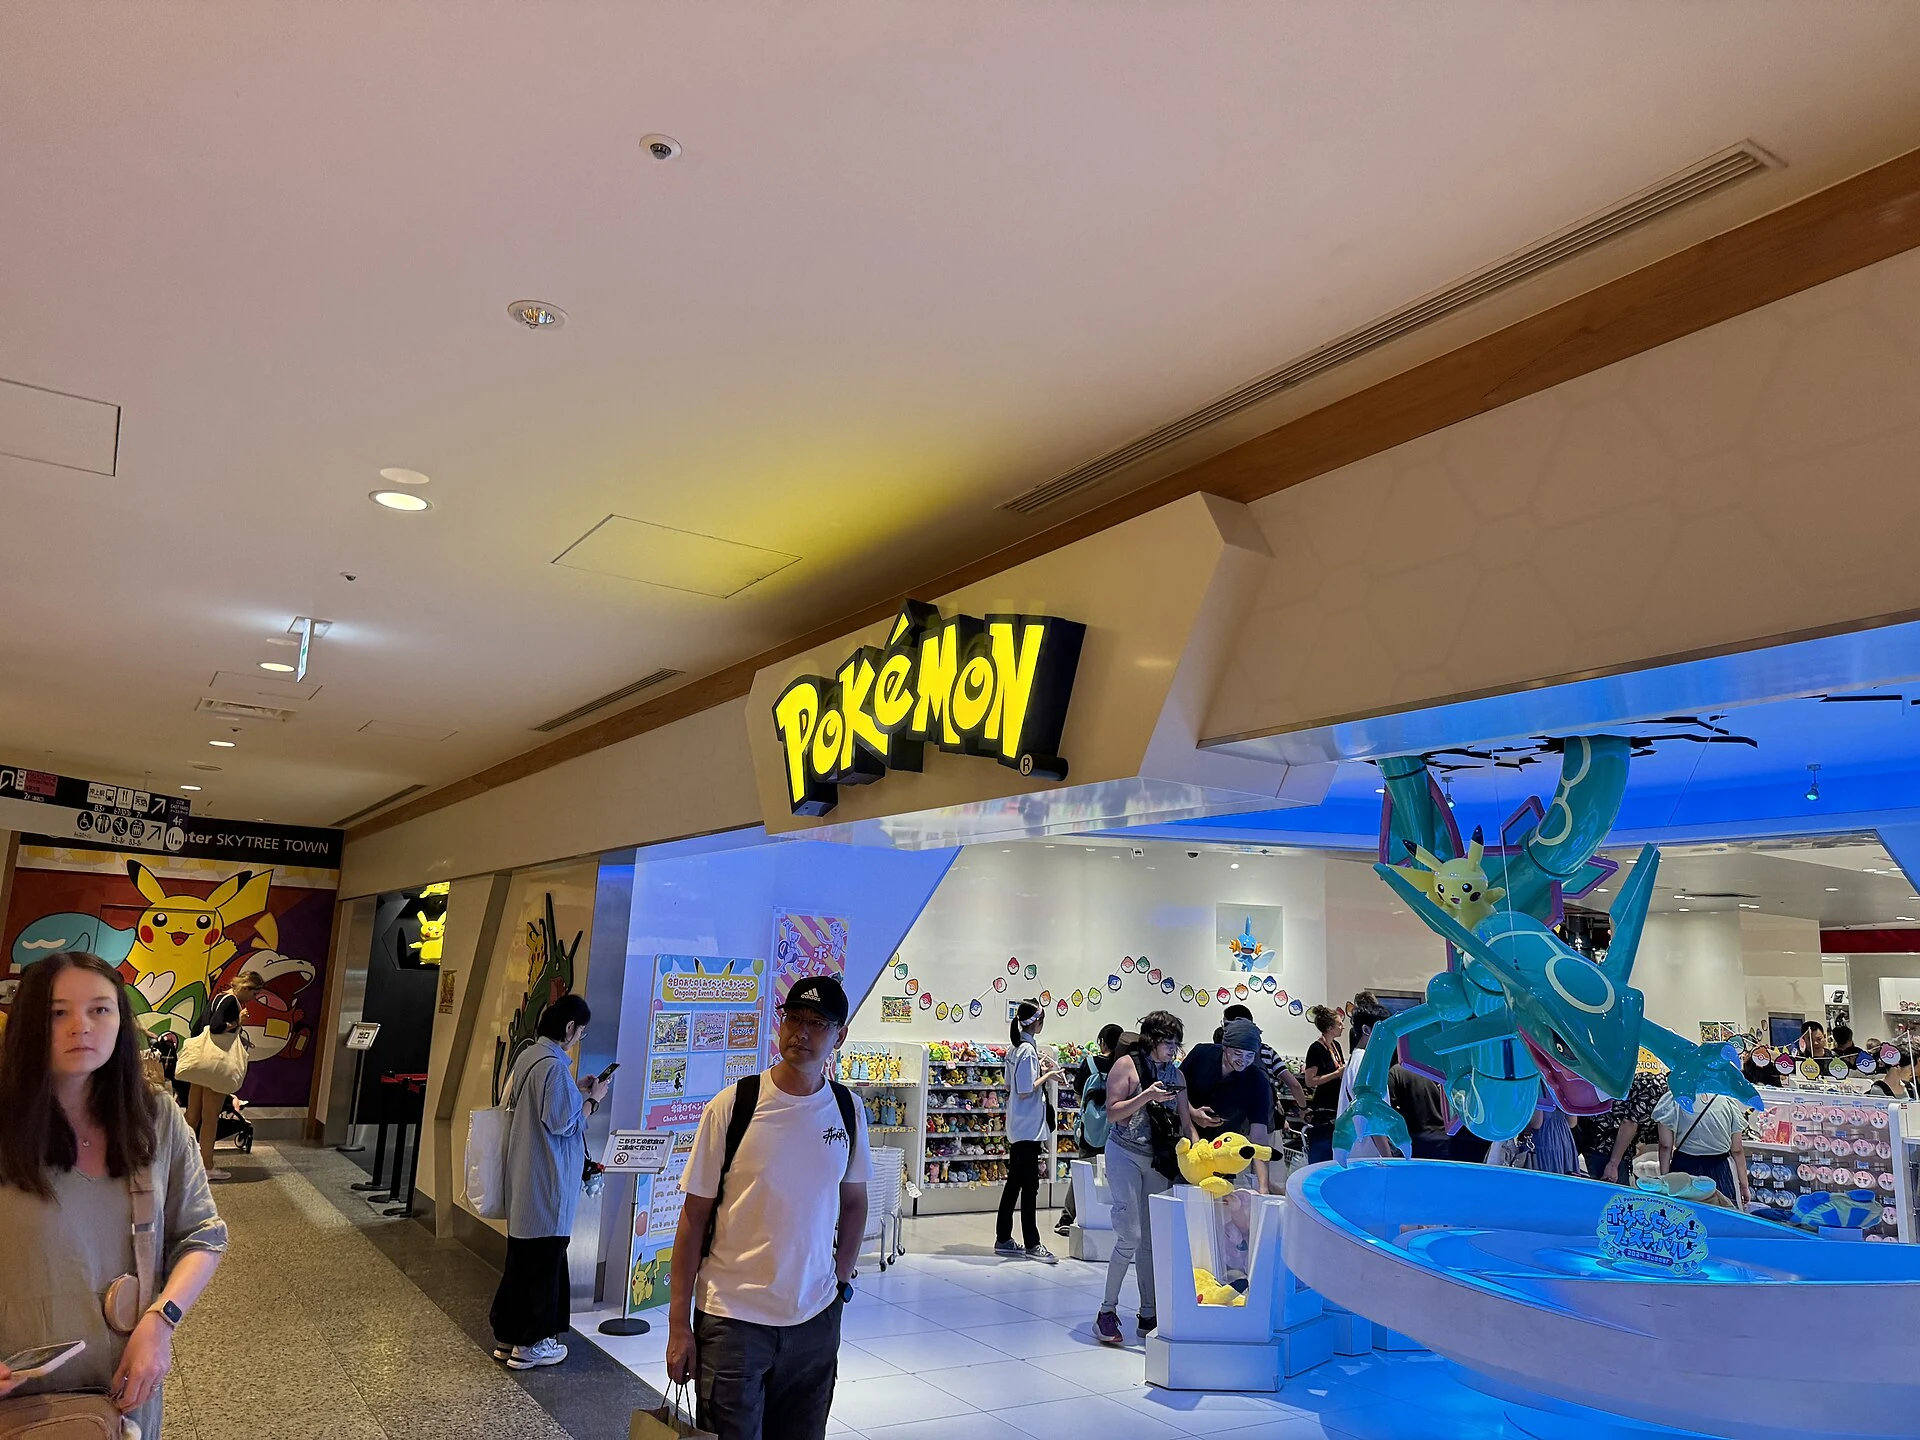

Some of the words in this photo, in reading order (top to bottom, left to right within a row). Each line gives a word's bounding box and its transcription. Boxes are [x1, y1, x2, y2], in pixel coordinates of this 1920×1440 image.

[172, 815, 184, 826] 4F
[216, 833, 280, 850] SKYTREE
[284, 839, 329, 854] TOWN
[674, 989, 697, 1000] Ongoing
[698, 989, 714, 998] Events
[715, 989, 720, 997] &
[721, 989, 748, 1000] Campaigns
[800, 993, 821, 1002] adidas
[663, 1114, 678, 1122] Check
[1606, 1204, 1698, 1240] ポケモンセンター
[1606, 1224, 1694, 1260] フェスティバル
[1627, 1249, 1645, 1259] 2024
